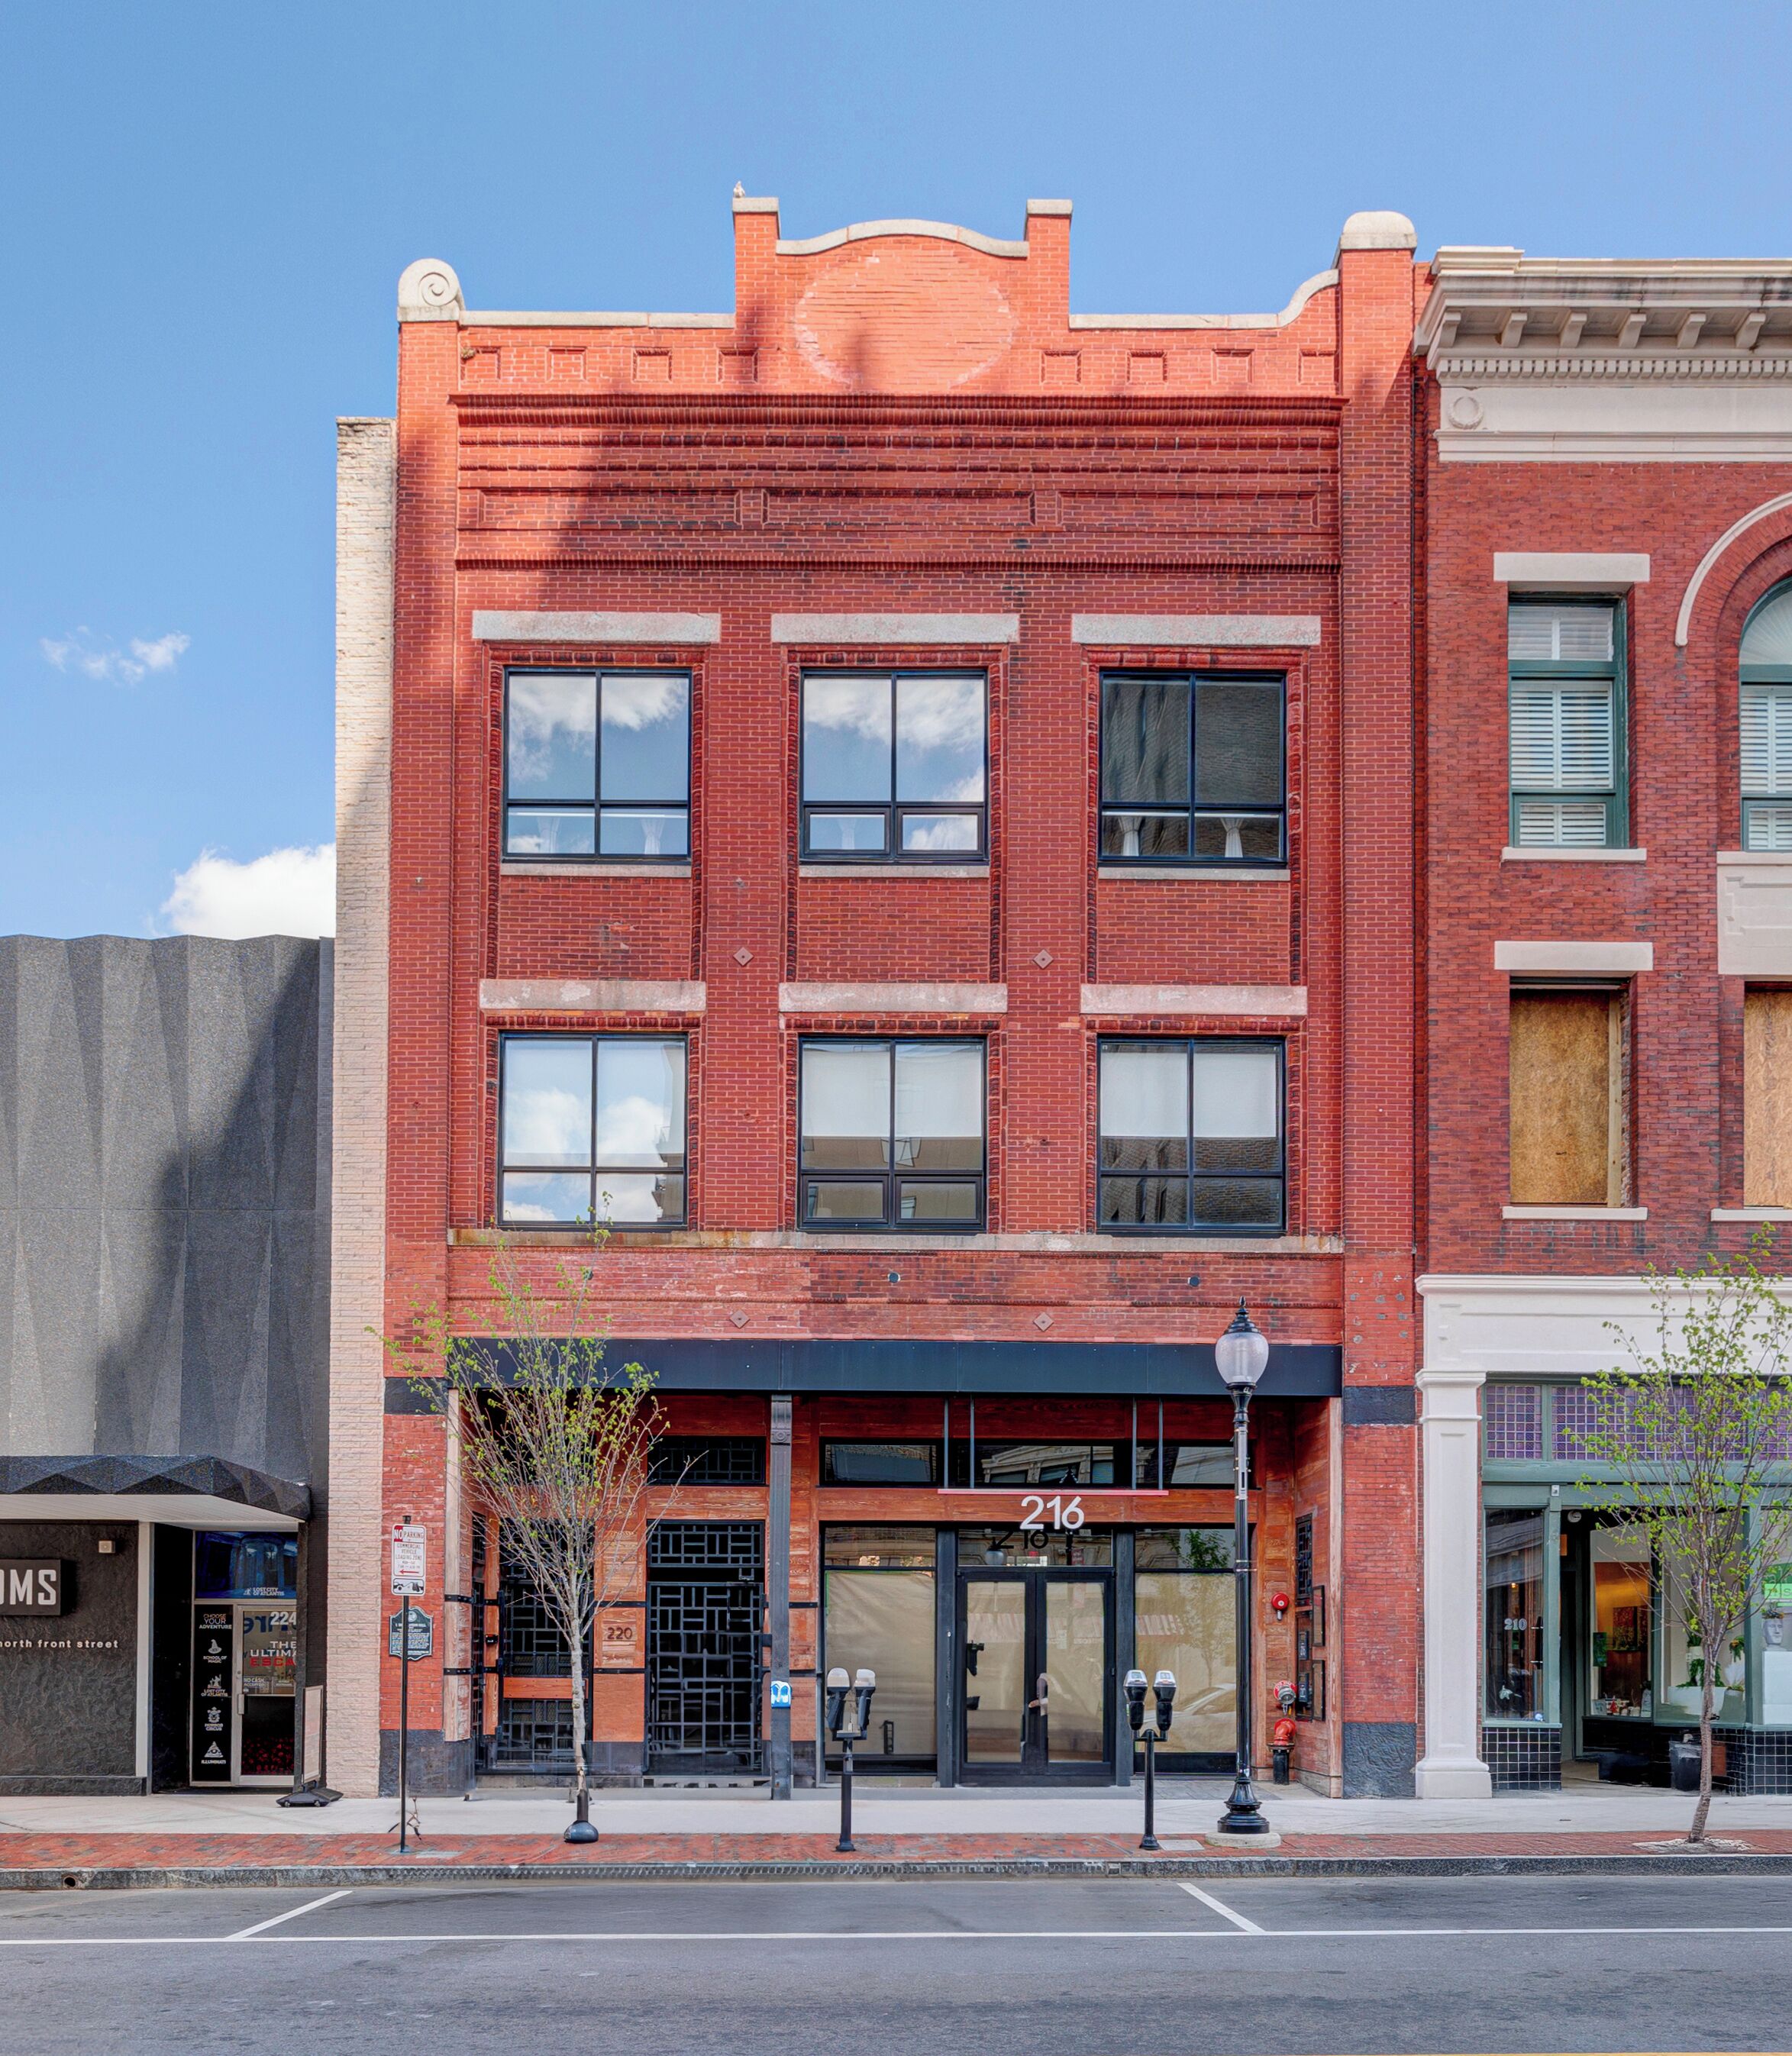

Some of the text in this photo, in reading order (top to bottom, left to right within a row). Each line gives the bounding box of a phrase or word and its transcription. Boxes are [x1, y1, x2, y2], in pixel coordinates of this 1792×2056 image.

[1019, 1495, 1084, 1530] 216
[394, 1529, 403, 1540] NO
[0, 1569, 57, 1605] MS
[270, 1611, 296, 1625] 224
[1504, 1619, 1527, 1631] 210
[607, 1627, 633, 1640] 220
[38, 1639, 71, 1648] front
[77, 1640, 118, 1648] street
[270, 1641, 297, 1649] THE
